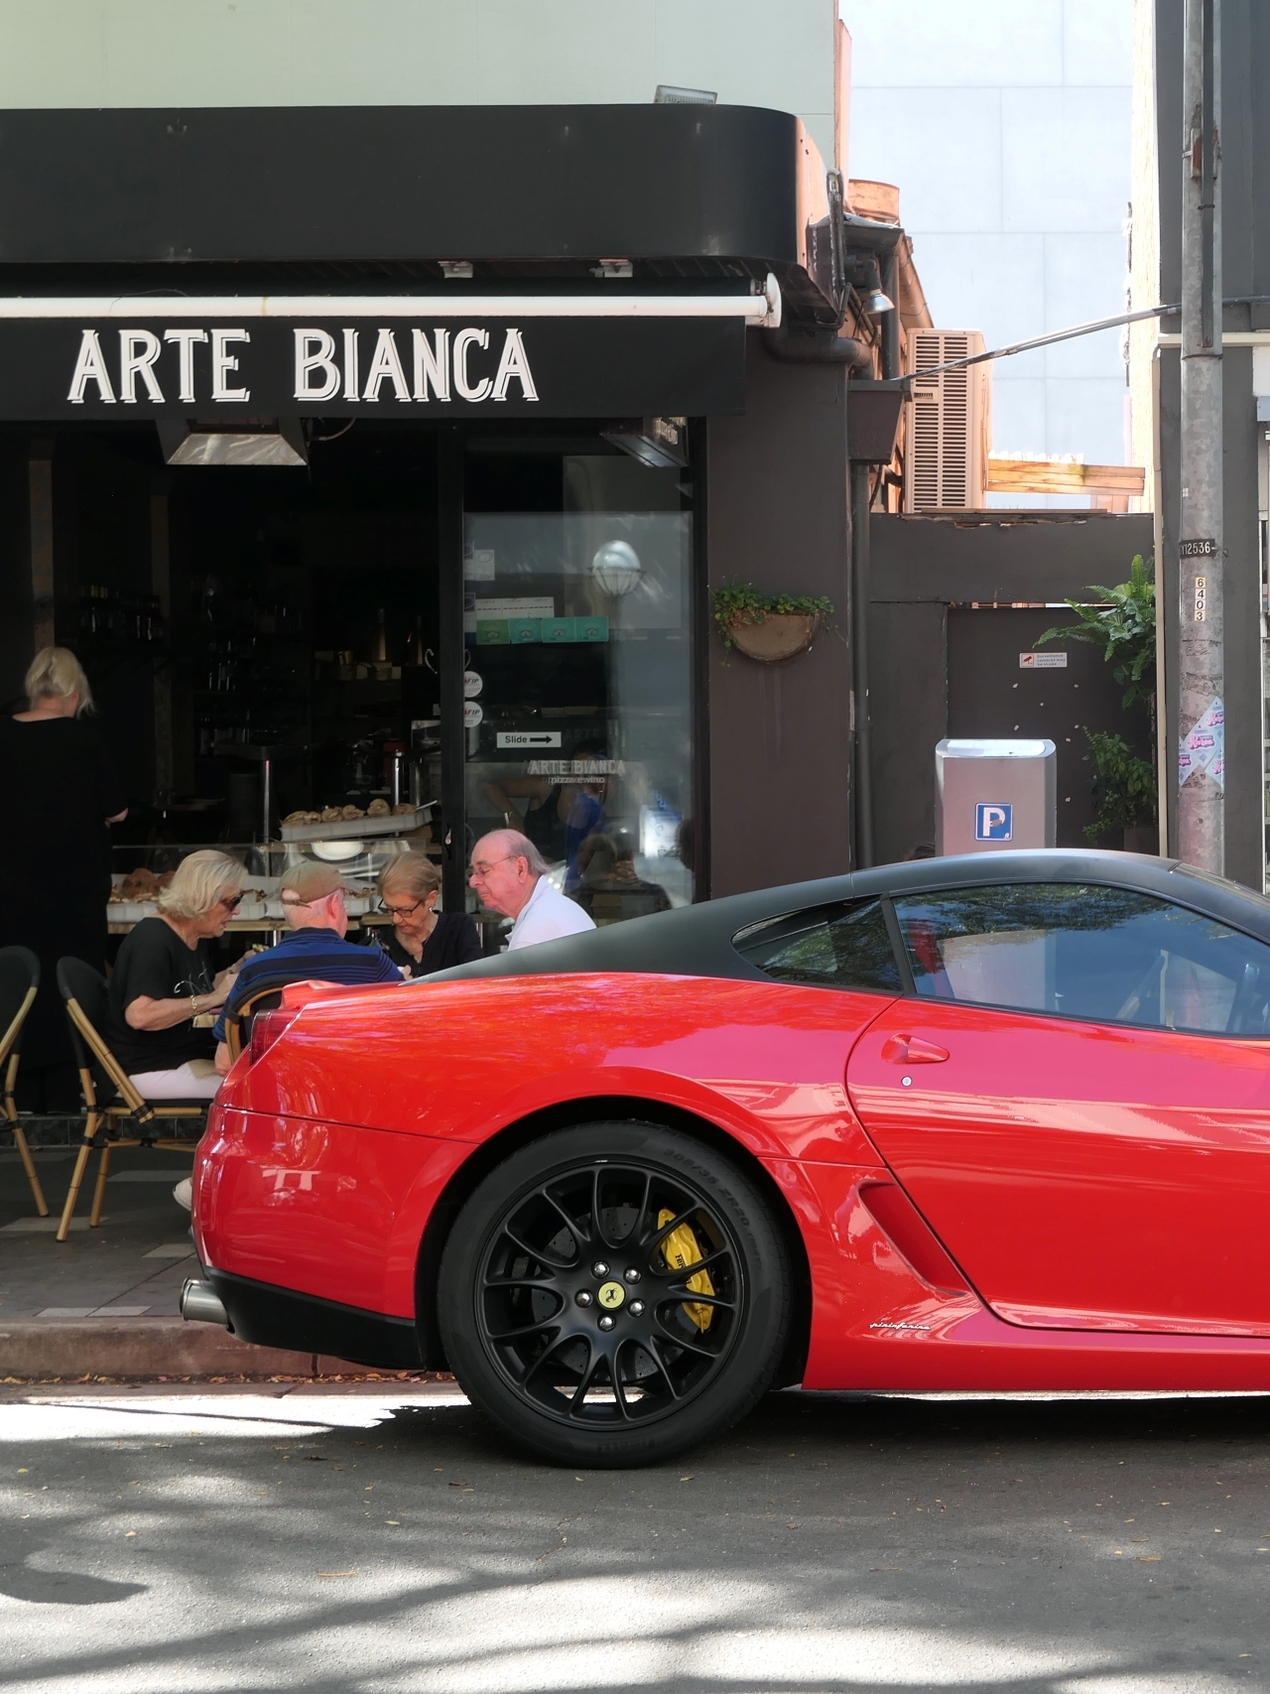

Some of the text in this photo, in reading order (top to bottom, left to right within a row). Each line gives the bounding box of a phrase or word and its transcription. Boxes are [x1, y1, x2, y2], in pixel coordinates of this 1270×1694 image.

[67, 328, 540, 404] ARTE BIANCA
[1196, 578, 1204, 620] 6403
[505, 736, 528, 744] Slide
[528, 760, 626, 774] ARTE BIANCA
[983, 807, 1005, 836] P
[870, 1321, 930, 1330] pininfarina
